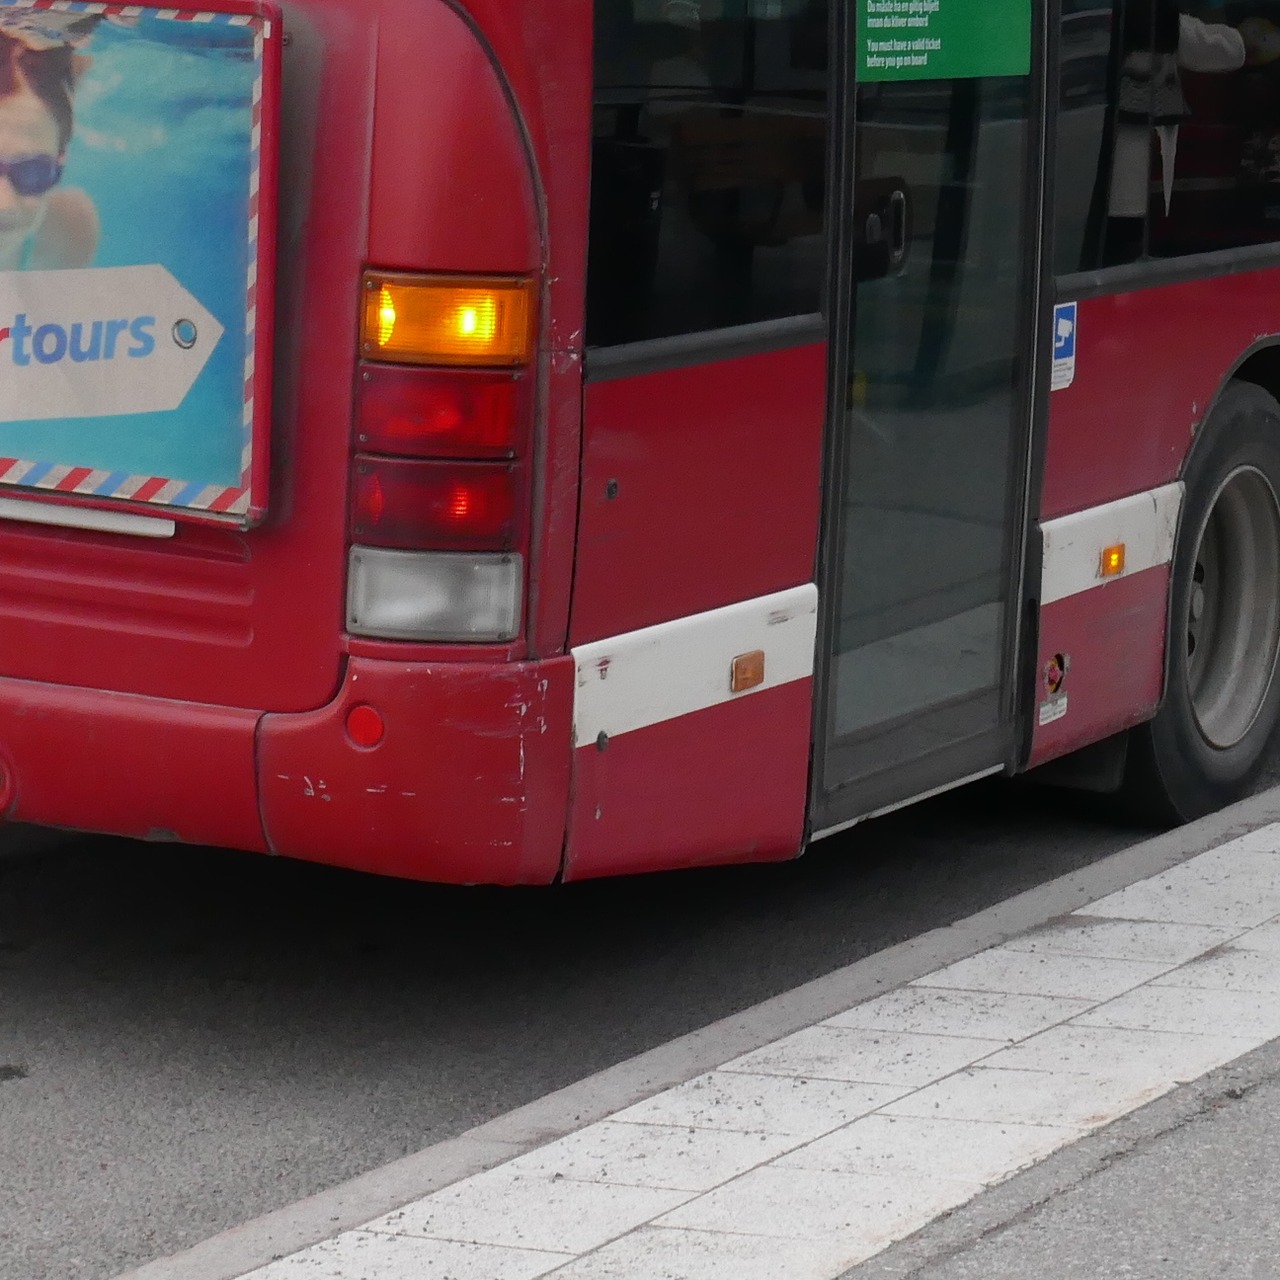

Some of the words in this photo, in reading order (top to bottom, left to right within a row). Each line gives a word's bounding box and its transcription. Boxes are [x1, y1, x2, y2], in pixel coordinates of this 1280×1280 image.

[867, 0, 875, 12] Du
[876, 0, 893, 12] måste
[894, 0, 901, 12] ha
[902, 2, 909, 12] en
[867, 39, 878, 51] You
[879, 39, 893, 51] must
[894, 38, 907, 51] have
[912, 38, 925, 50] valid
[925, 37, 941, 50] ticket
[867, 54, 885, 67] before
[885, 56, 896, 69] you
[896, 56, 903, 69] go
[911, 52, 927, 66] board
